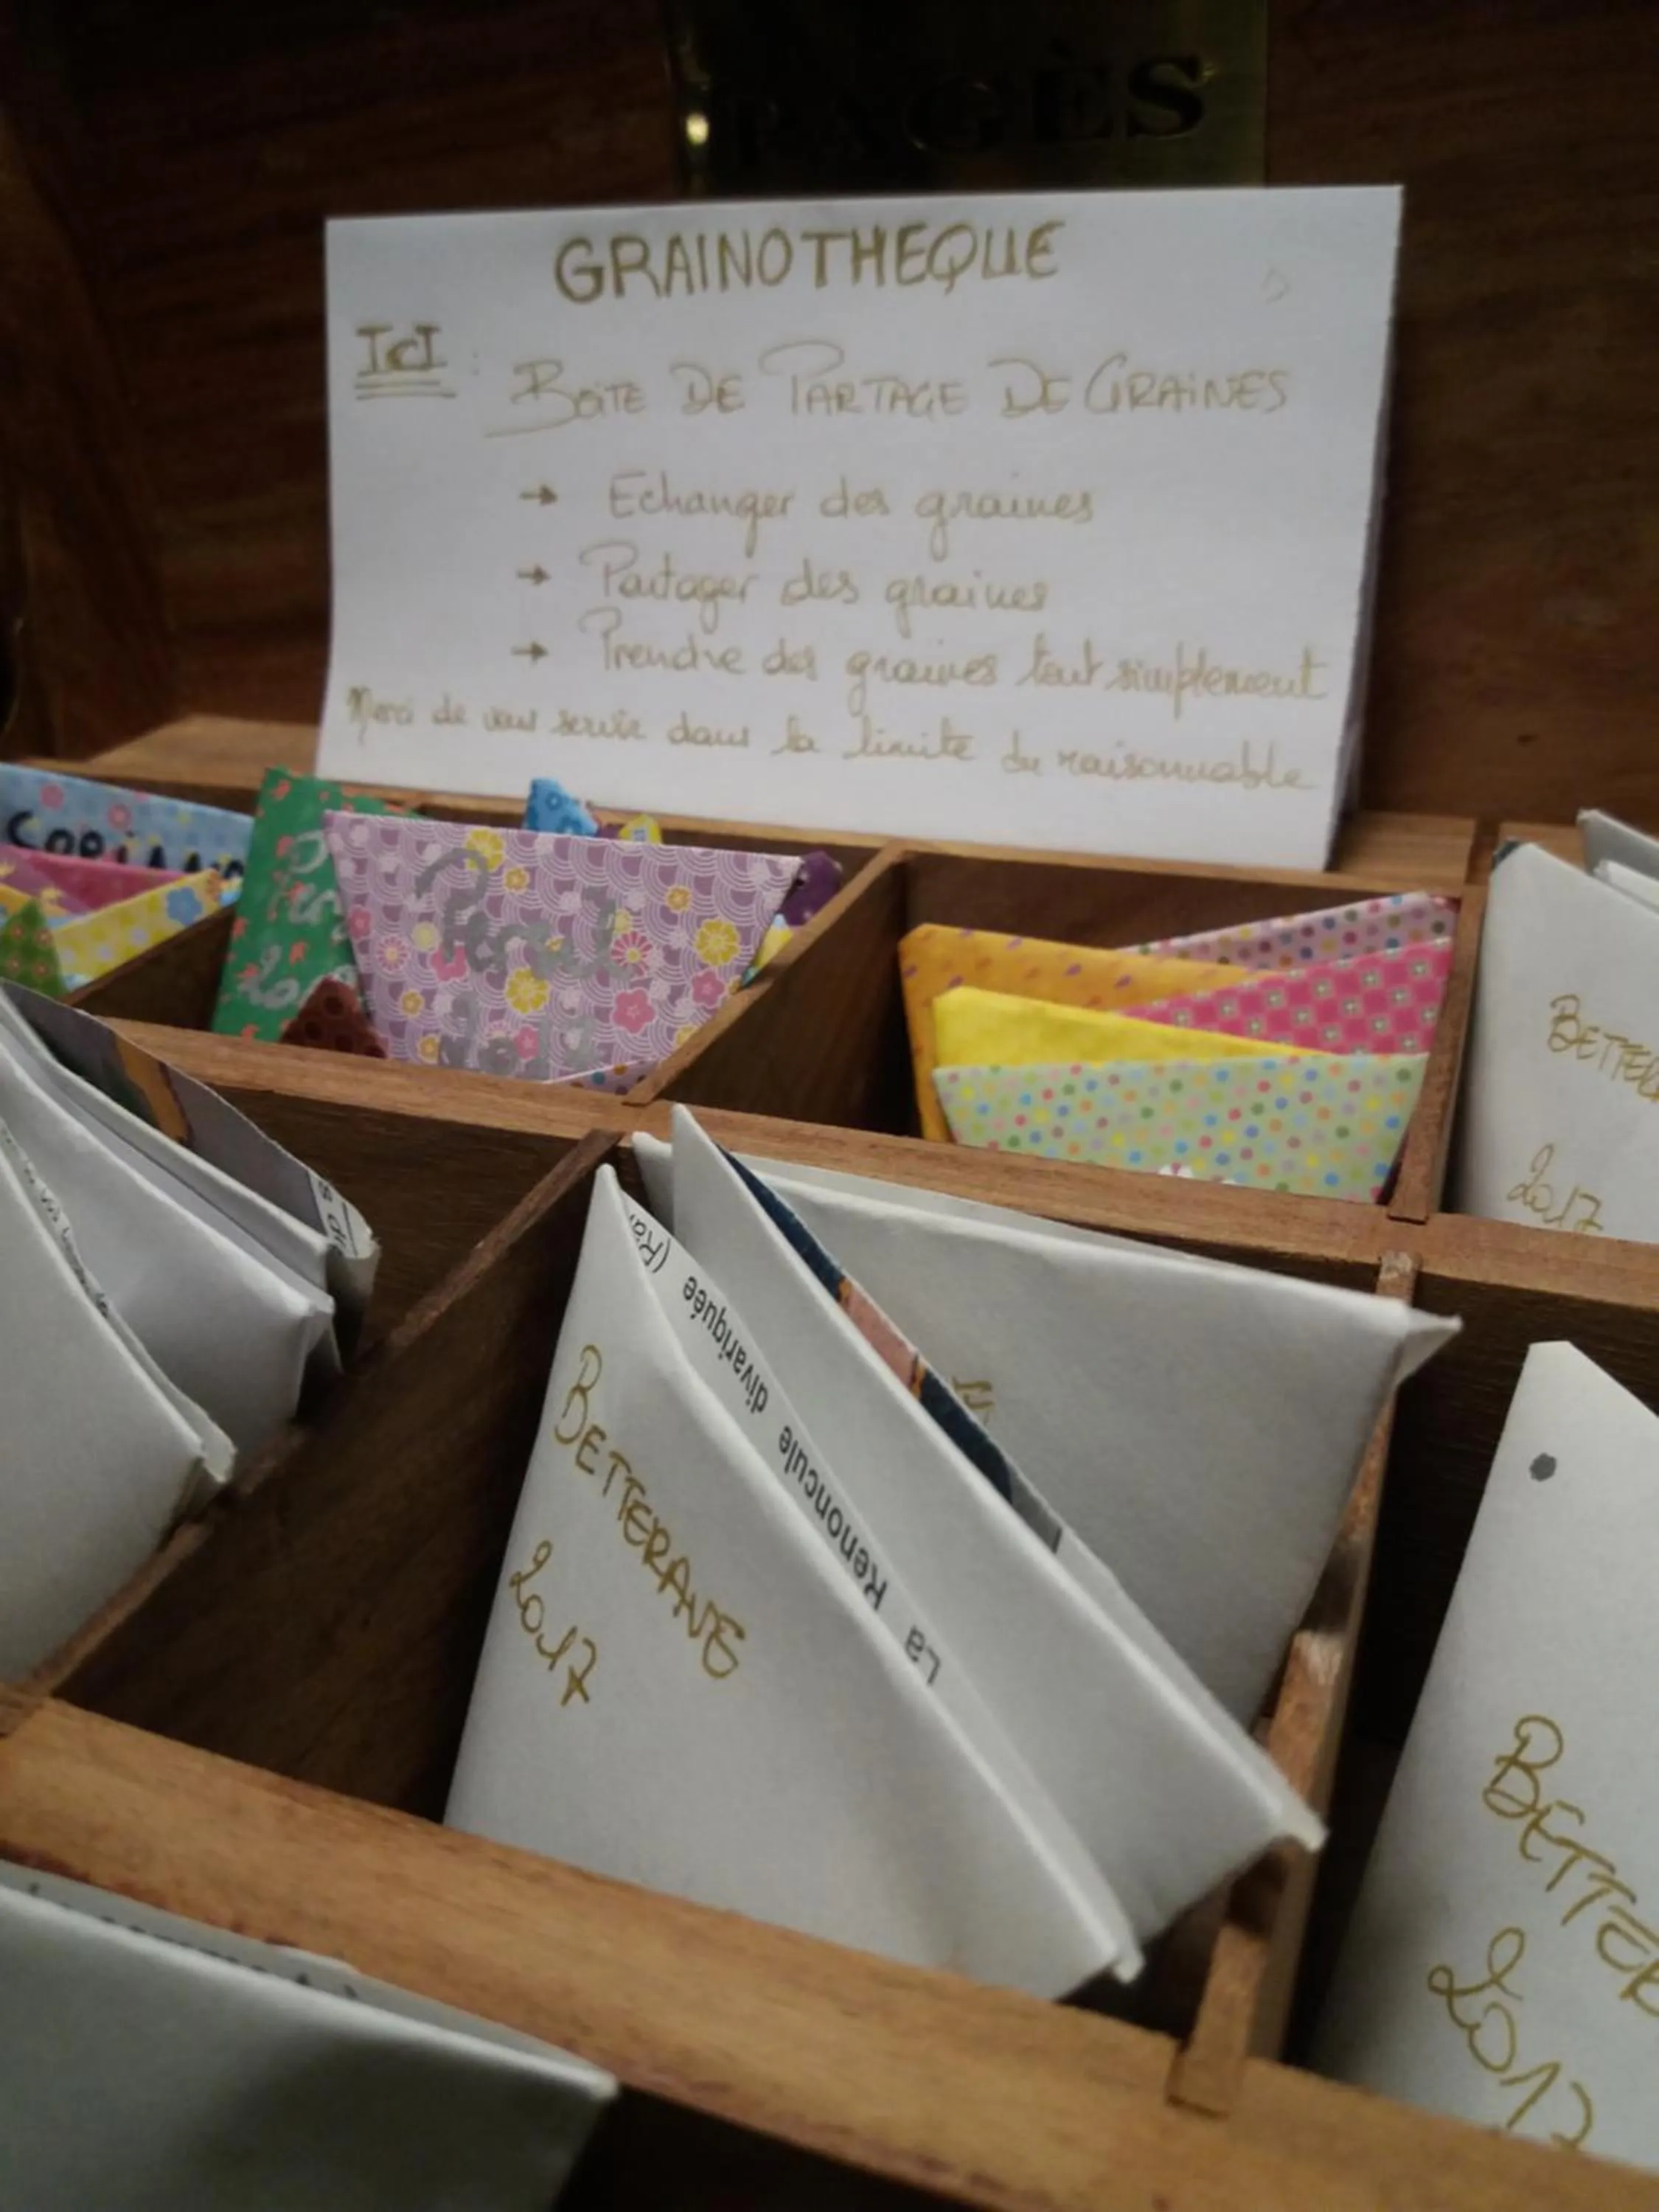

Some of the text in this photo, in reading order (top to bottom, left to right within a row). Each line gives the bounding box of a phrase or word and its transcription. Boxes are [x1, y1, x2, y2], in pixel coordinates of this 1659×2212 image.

[553, 220, 1066, 305] GRAINOTHEQUE
[669, 362, 746, 415] DE
[758, 340, 970, 417] PARTAGE
[987, 357, 1071, 417] DE
[609, 470, 1096, 563] Echanger des graines
[579, 541, 1050, 639] Partager des graines
[577, 606, 745, 674] Prendre
[845, 639, 998, 717] graines
[1015, 632, 1104, 688] tout
[1105, 639, 1329, 722] simplement
[431, 691, 469, 727] de
[668, 711, 749, 748] dans
[771, 715, 821, 757] la
[843, 714, 977, 760] limite
[554, 1344, 745, 1679] BETTERAVE
[776, 1424, 890, 1613] Renoncule
[509, 1540, 599, 1707] 2017
[902, 1624, 943, 1688] La
